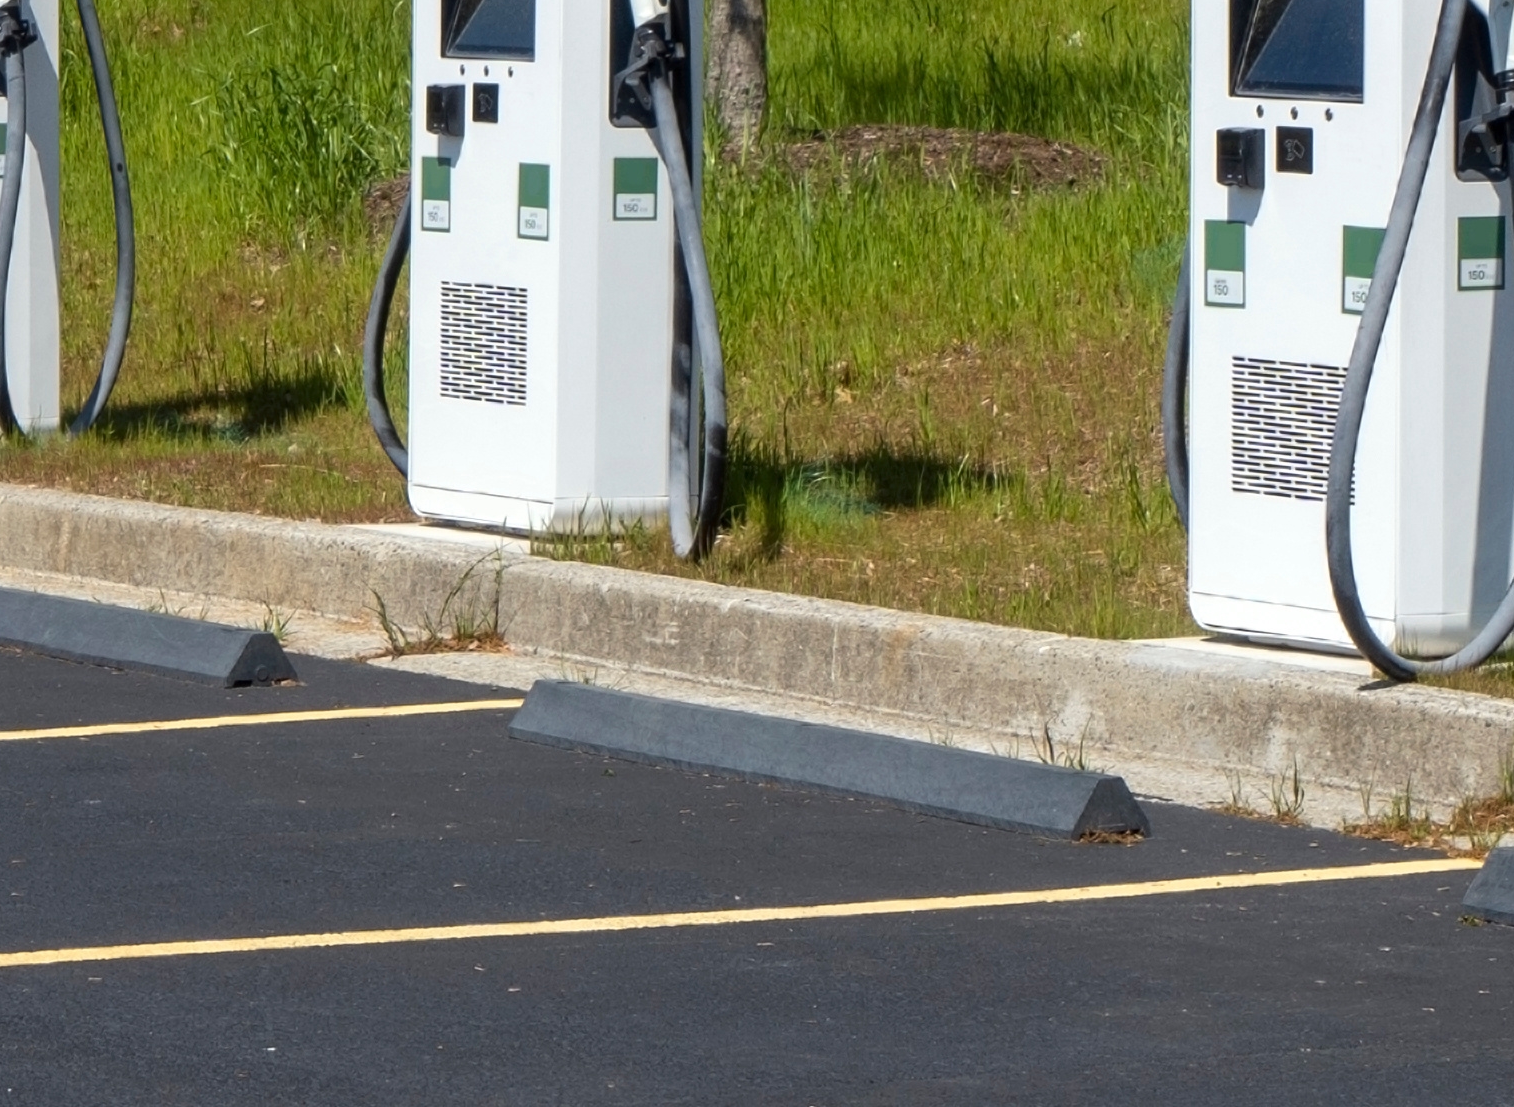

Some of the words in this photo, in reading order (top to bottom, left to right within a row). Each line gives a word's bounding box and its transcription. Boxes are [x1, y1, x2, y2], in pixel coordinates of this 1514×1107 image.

[623, 203, 638, 212] 150
[1468, 270, 1485, 280] 150
[1213, 284, 1228, 296] 150
[1352, 291, 1367, 303] 150
